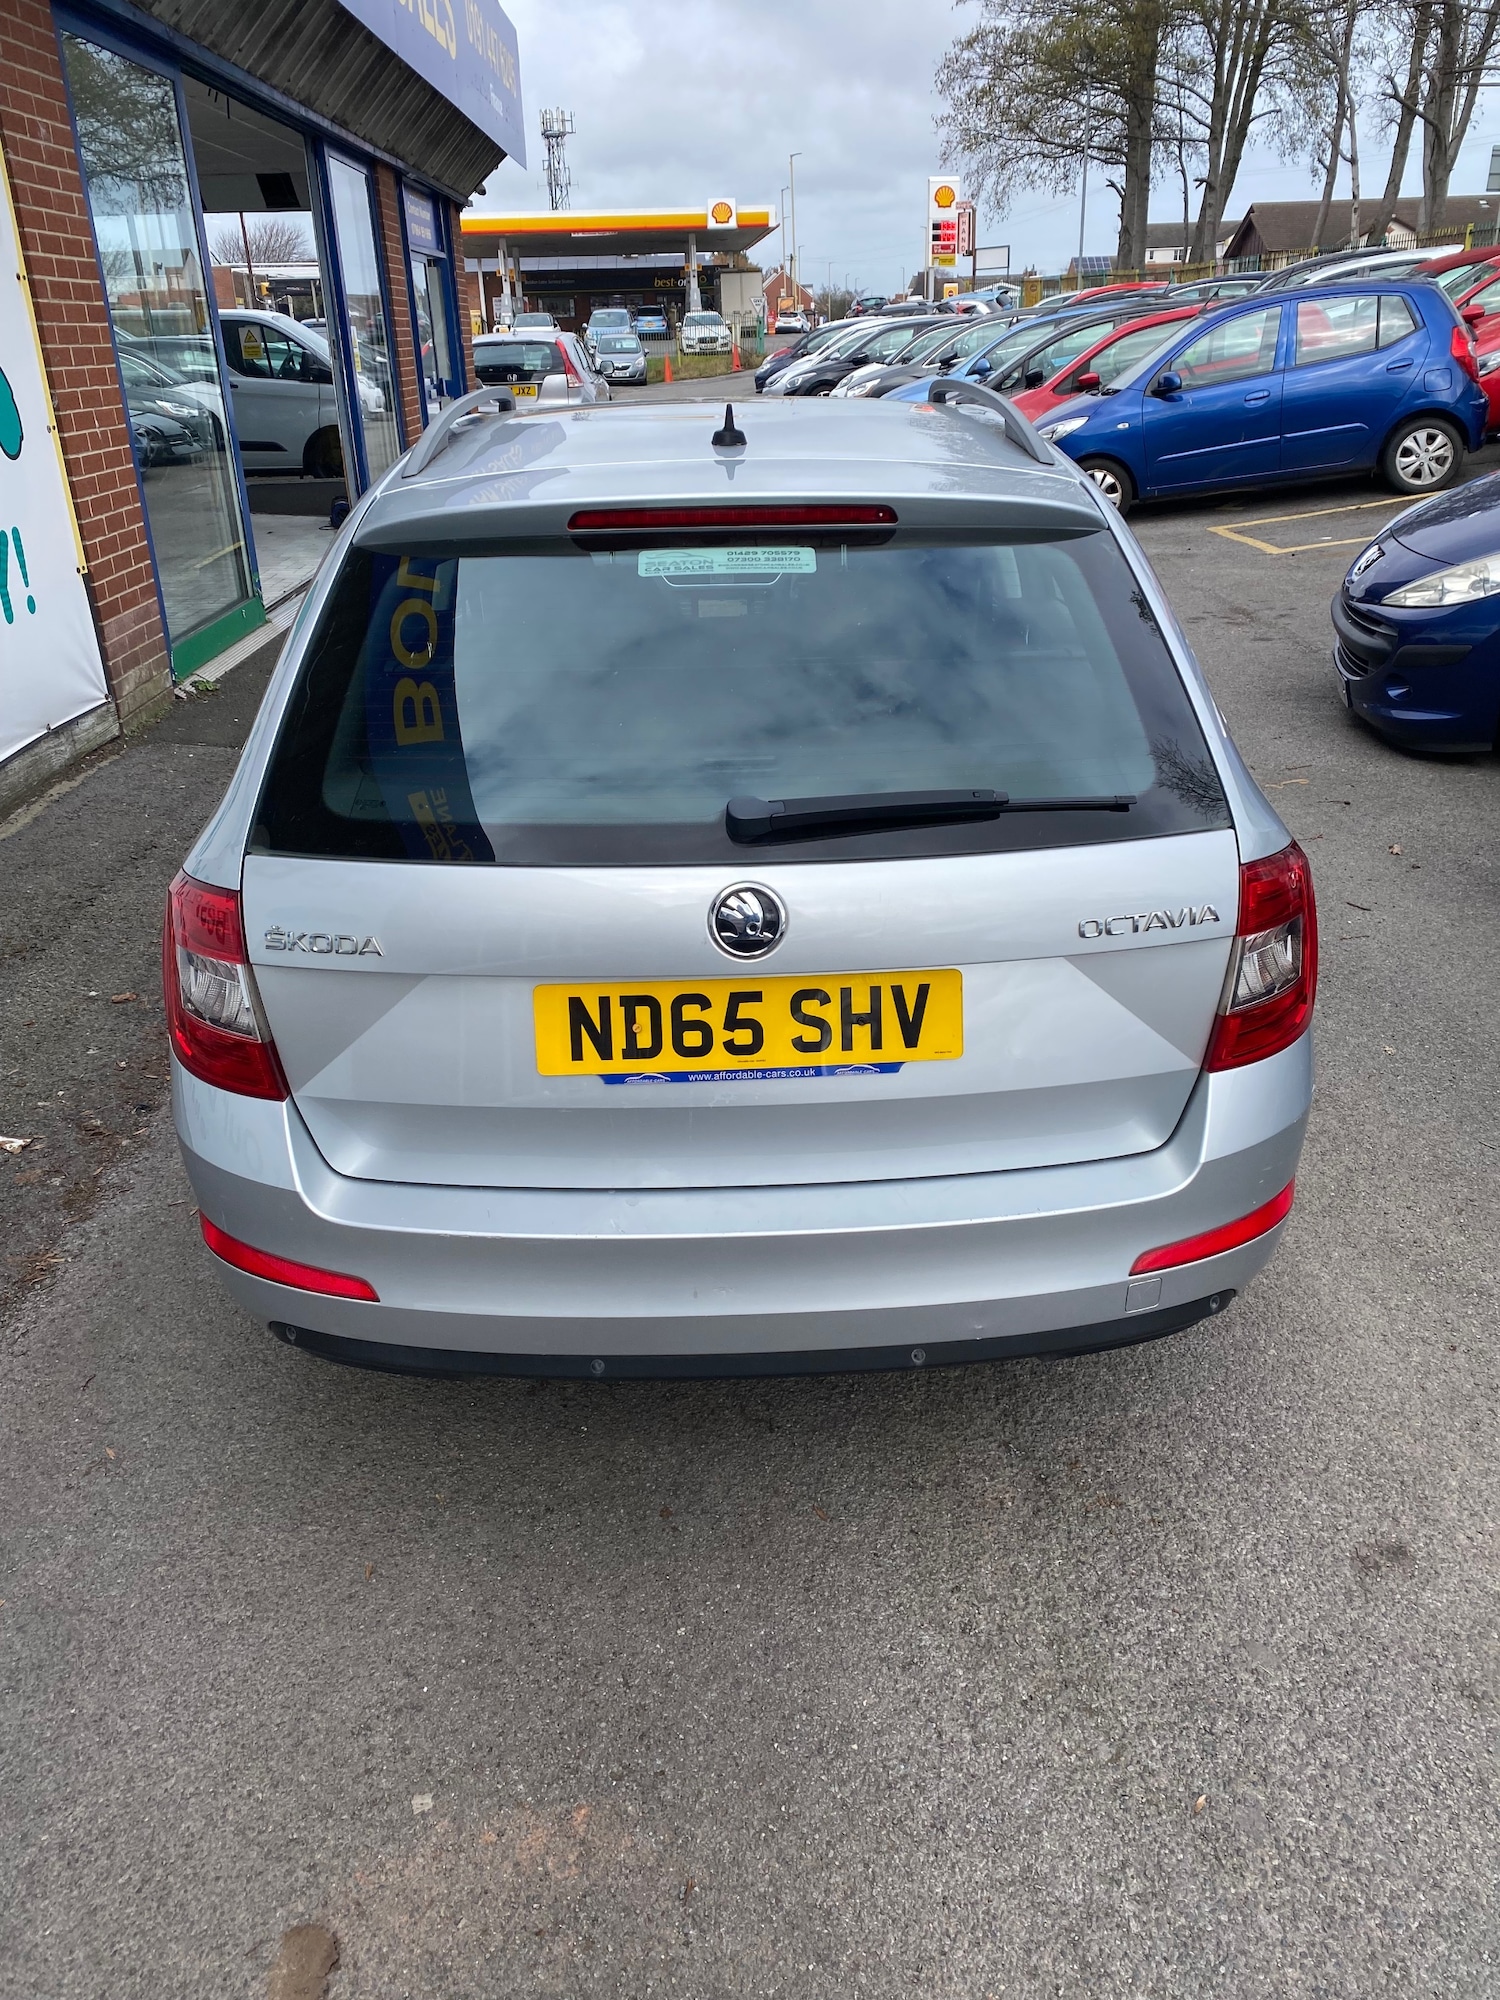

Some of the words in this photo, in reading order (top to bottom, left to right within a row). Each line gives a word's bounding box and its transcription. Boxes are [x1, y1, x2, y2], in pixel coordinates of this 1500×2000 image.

[516, 386, 531, 395] JXZ
[645, 559, 714, 567] SEATON
[1078, 904, 1221, 938] OCTAVIA
[264, 925, 384, 957] ŠKODA
[567, 990, 764, 1061] ND65
[790, 983, 930, 1053] SHV
[688, 1068, 815, 1081] www.affordable-cars.co.uk
